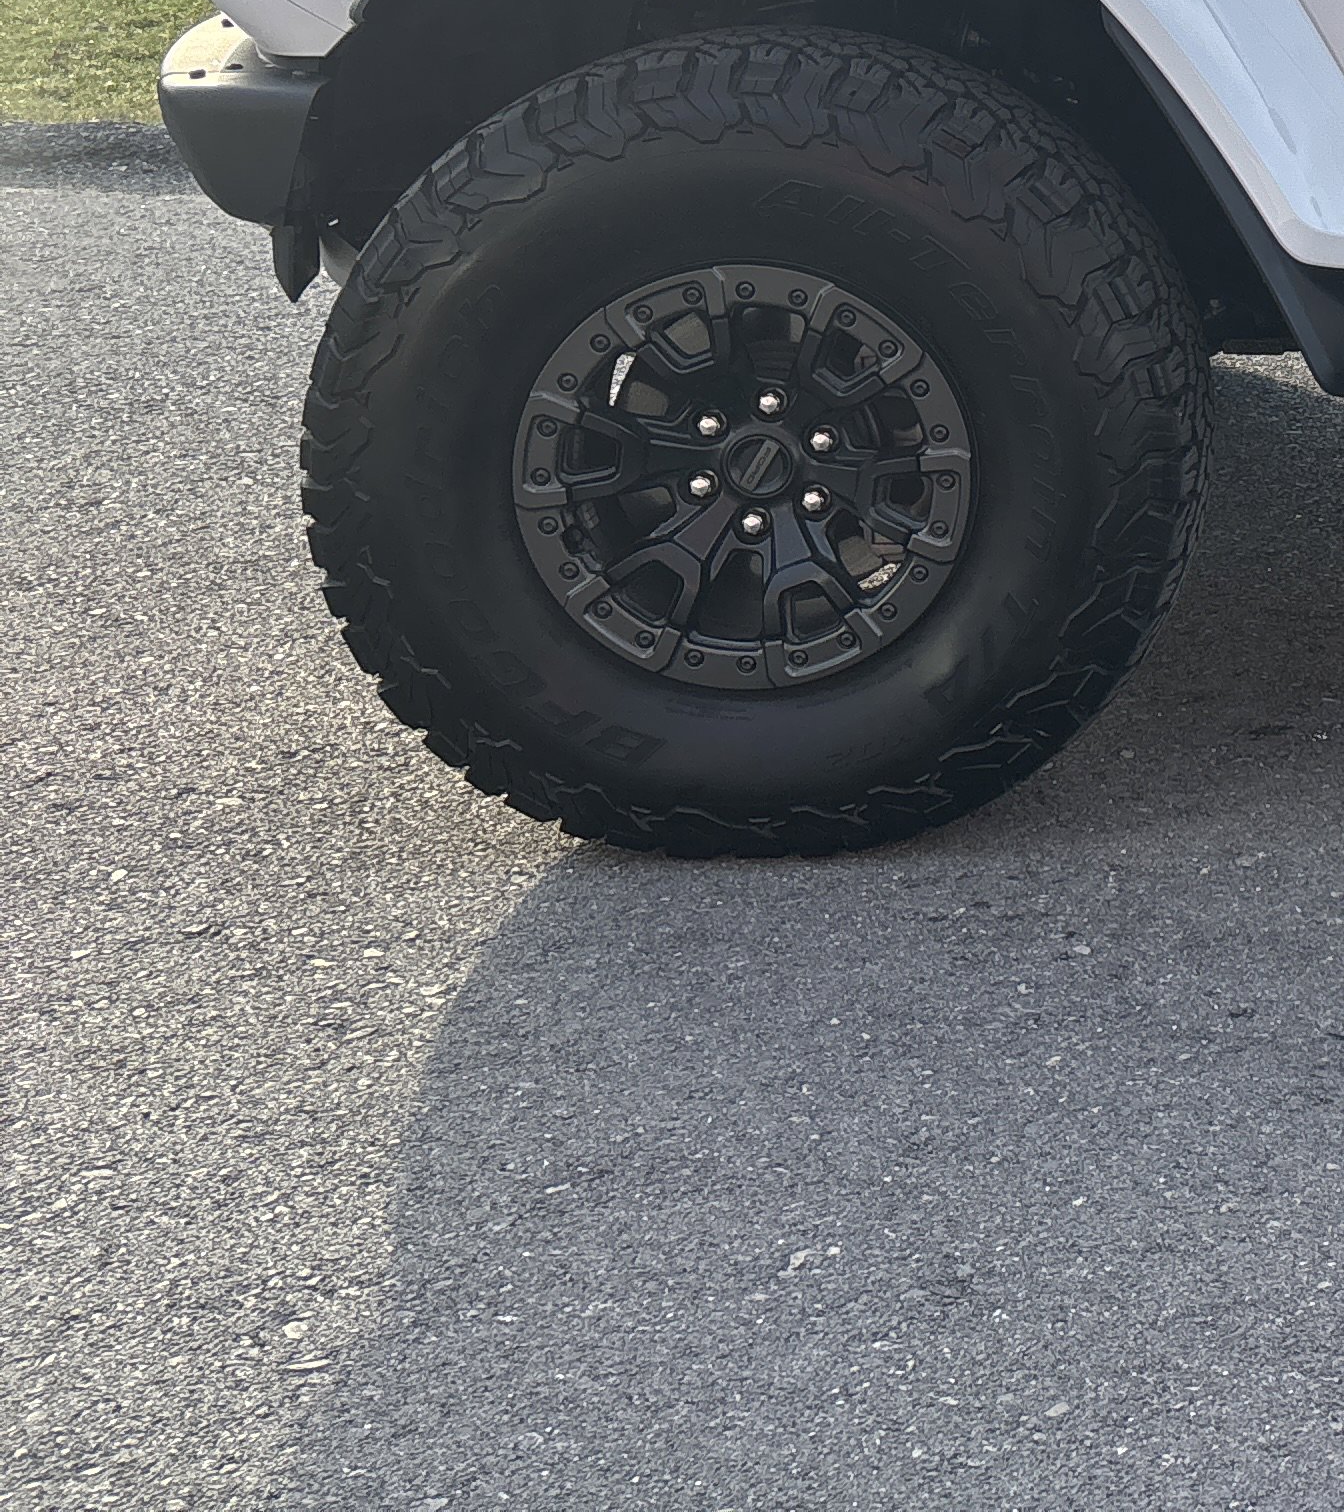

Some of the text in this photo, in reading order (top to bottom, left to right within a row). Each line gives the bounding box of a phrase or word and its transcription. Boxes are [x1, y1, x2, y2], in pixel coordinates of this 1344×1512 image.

[400, 283, 667, 770] BFGoodrich
[746, 446, 773, 485] FORD
[752, 178, 1067, 562] All-Terrain
[920, 591, 1040, 719] T/A
